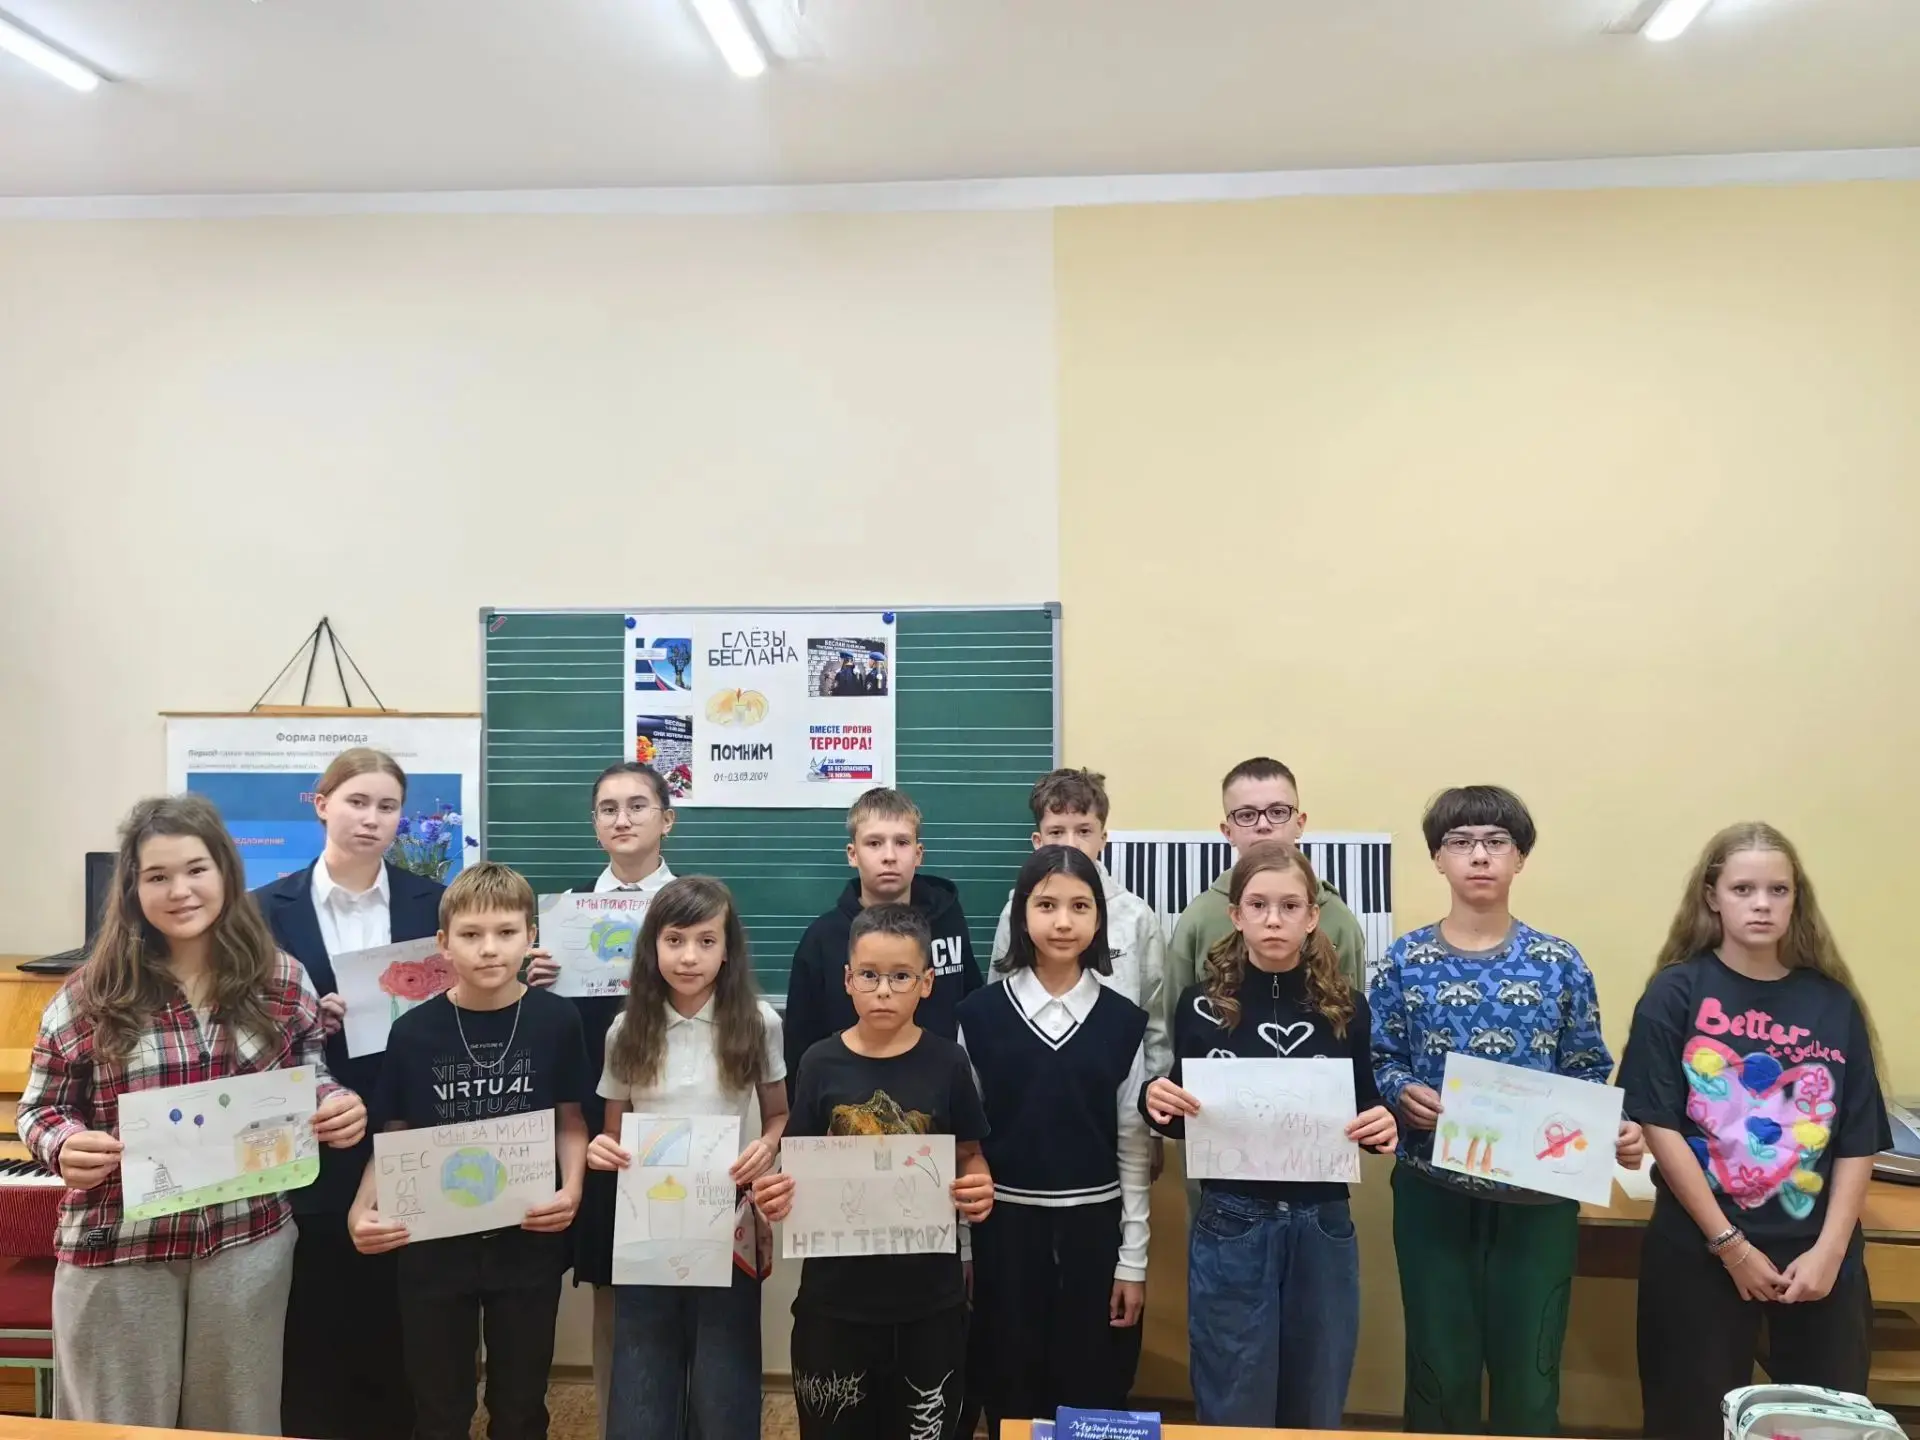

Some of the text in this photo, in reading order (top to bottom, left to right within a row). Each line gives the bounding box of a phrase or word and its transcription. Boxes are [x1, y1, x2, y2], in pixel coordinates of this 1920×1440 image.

[722, 627, 786, 648] СЛЁЗЫ
[708, 646, 798, 666] БЕСЛАНА
[276, 732, 368, 743] Форма периода
[809, 725, 872, 734] ВМЕСТЕ ПРОТИВ
[711, 743, 773, 761] ПОМНИМ
[809, 736, 872, 750] ТЕРРОРА!
[1694, 997, 1811, 1045] Better
[1765, 1039, 1846, 1064] together
[432, 1059, 537, 1081] VIRTUAL
[433, 1076, 534, 1101] VIRTUAL
[434, 1095, 531, 1119] VIRTUAL
[496, 1115, 545, 1141] МИР!
[380, 1150, 432, 1176] БЕС
[792, 1230, 845, 1256] НЕТ
